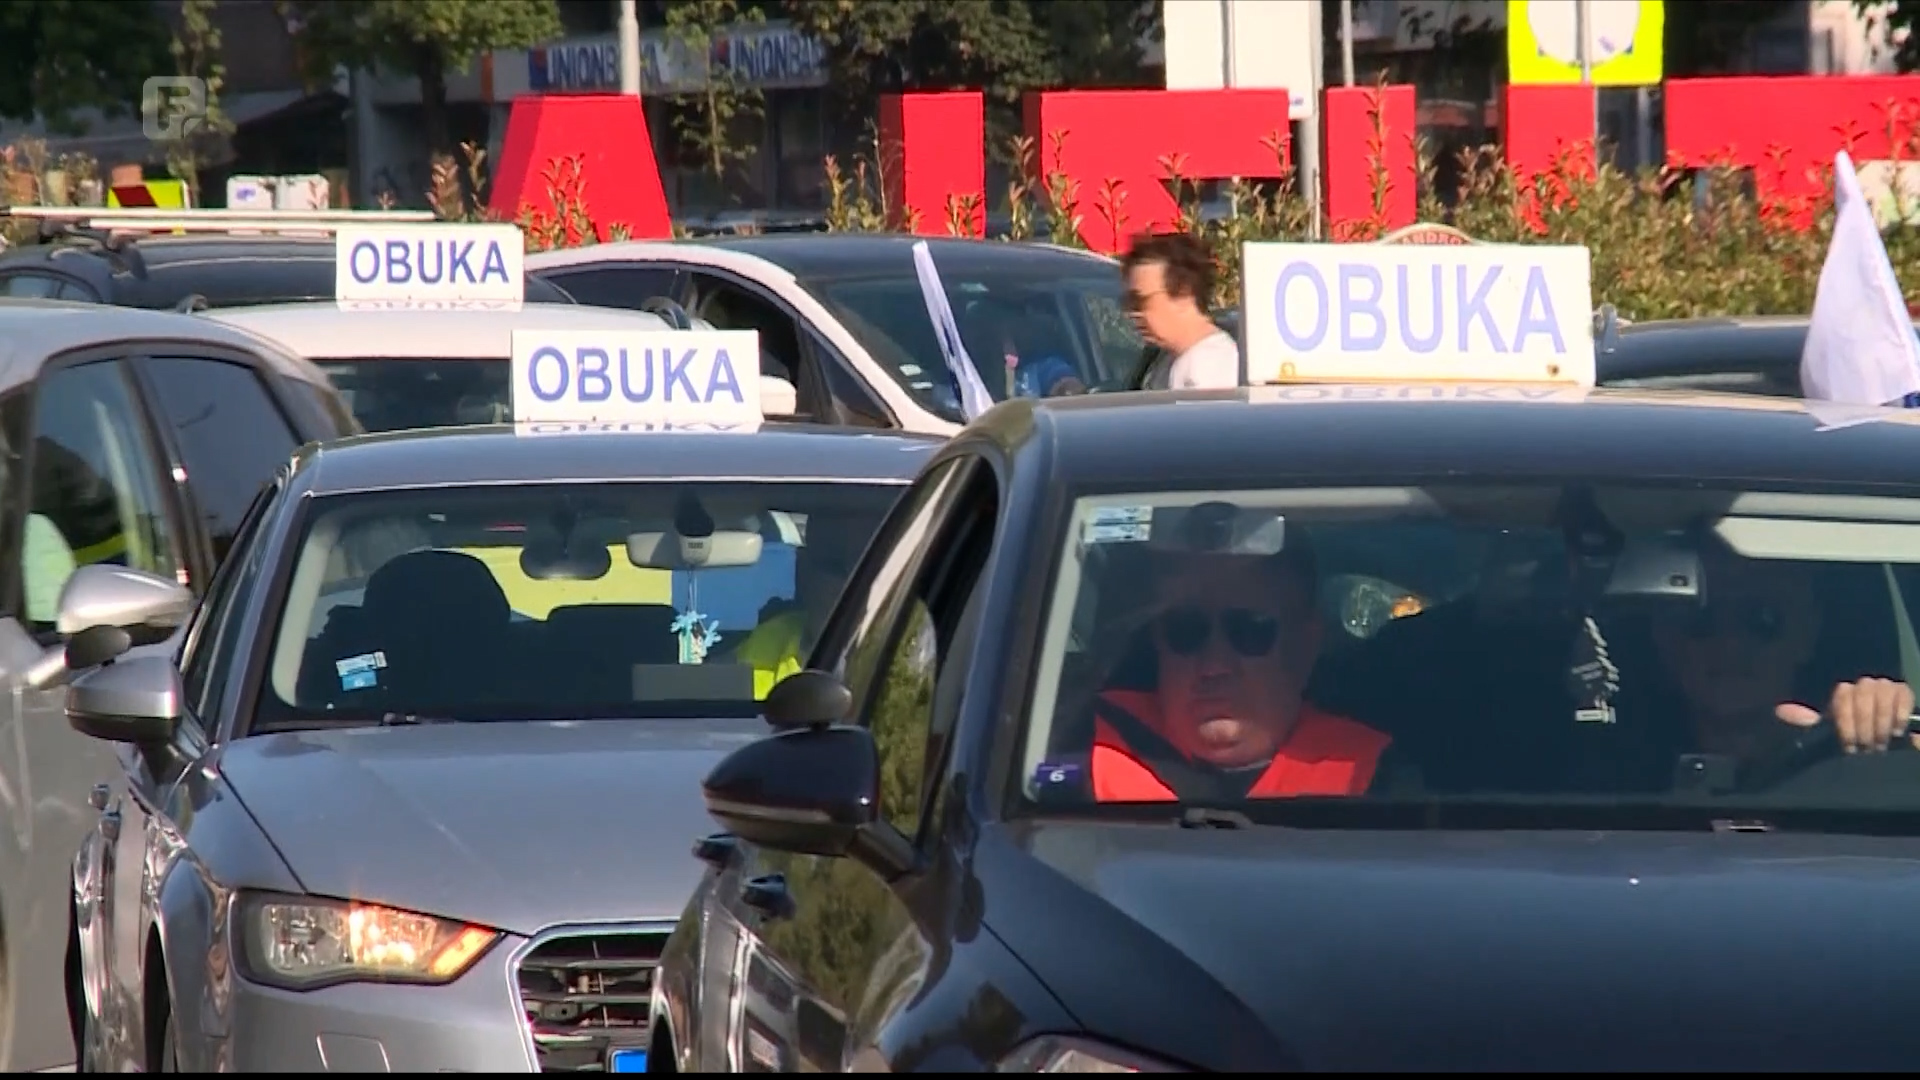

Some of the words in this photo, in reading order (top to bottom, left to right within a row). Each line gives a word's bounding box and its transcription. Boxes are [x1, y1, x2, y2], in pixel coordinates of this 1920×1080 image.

[349, 239, 511, 285] OBUKA
[1275, 261, 1567, 353] OBUKA
[527, 346, 745, 404] OBUKA
[1049, 769, 1066, 783] 6
